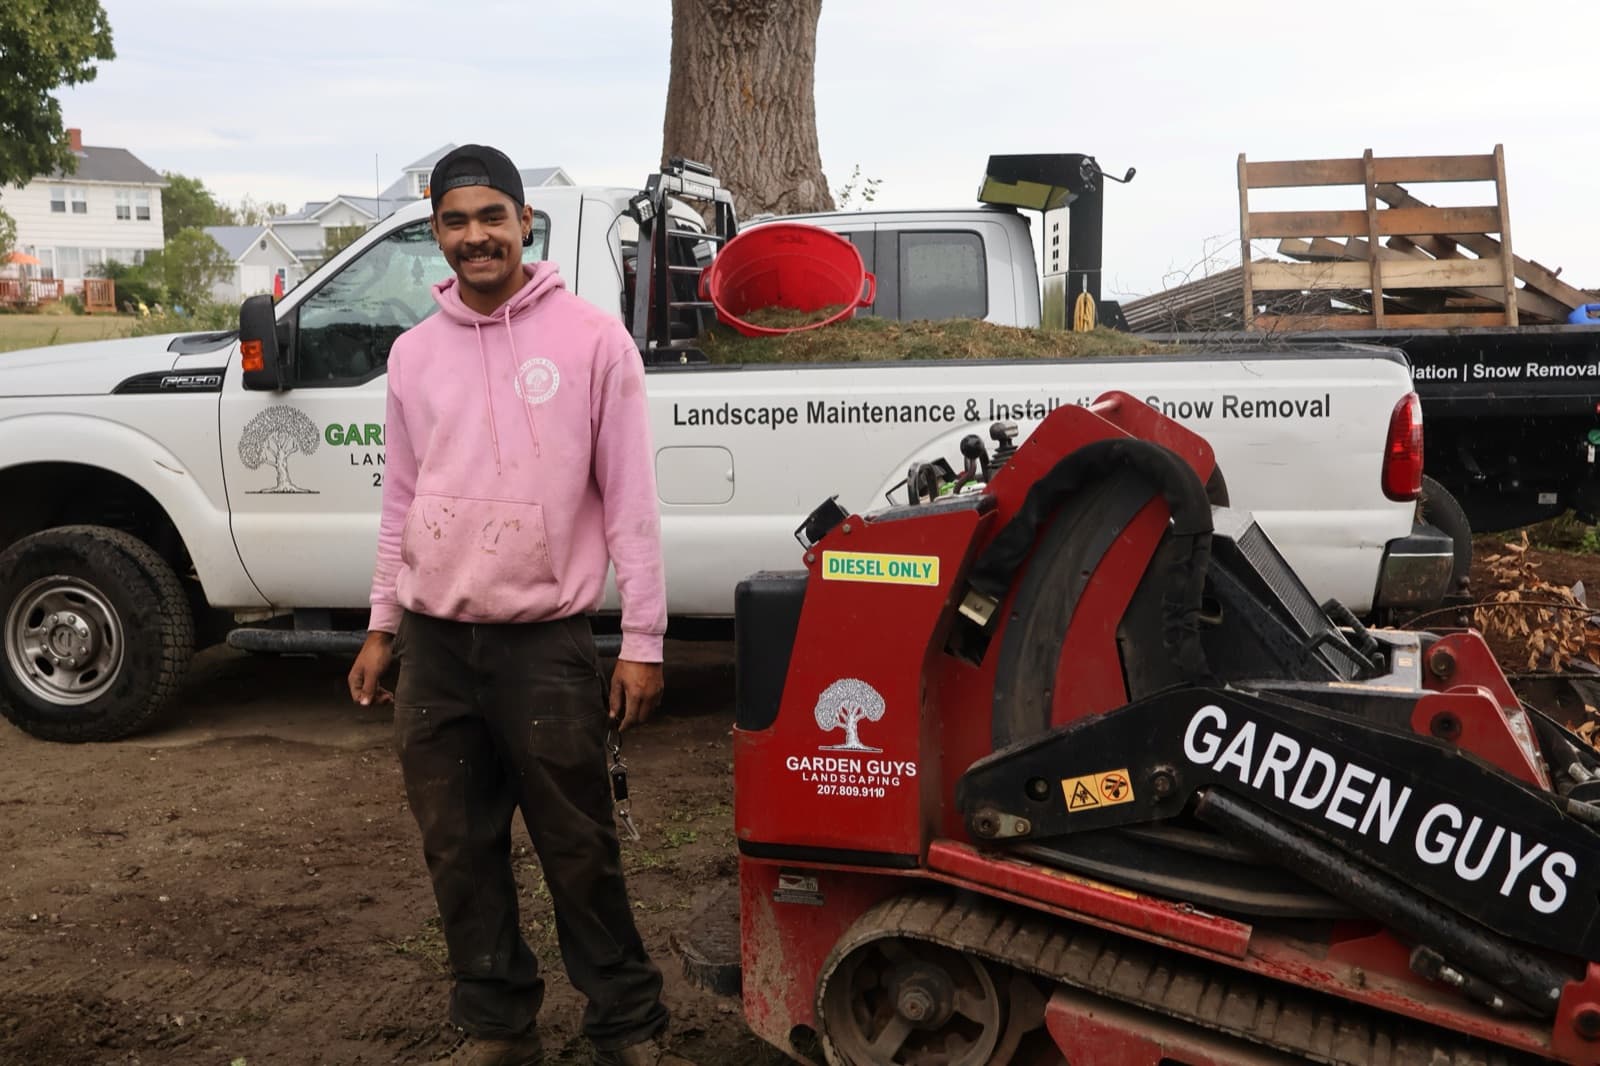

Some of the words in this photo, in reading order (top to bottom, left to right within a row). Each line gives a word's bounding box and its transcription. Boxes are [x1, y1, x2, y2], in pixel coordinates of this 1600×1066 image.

[1473, 363, 1522, 379] Snow
[674, 403, 798, 430] Landscape
[806, 401, 955, 424] Maintenance
[963, 398, 981, 421] &
[1222, 393, 1331, 419] Removal
[324, 423, 385, 446] GAR
[829, 558, 885, 576] DIESEL
[888, 561, 932, 579] ONLY
[786, 756, 861, 773] GARDEN
[866, 760, 917, 777] GUYS
[802, 772, 900, 787] LANDSCAPING
[816, 784, 885, 797] 207.809.9110
[1184, 704, 1412, 844] GARDEN
[1415, 803, 1577, 914] GUYS
